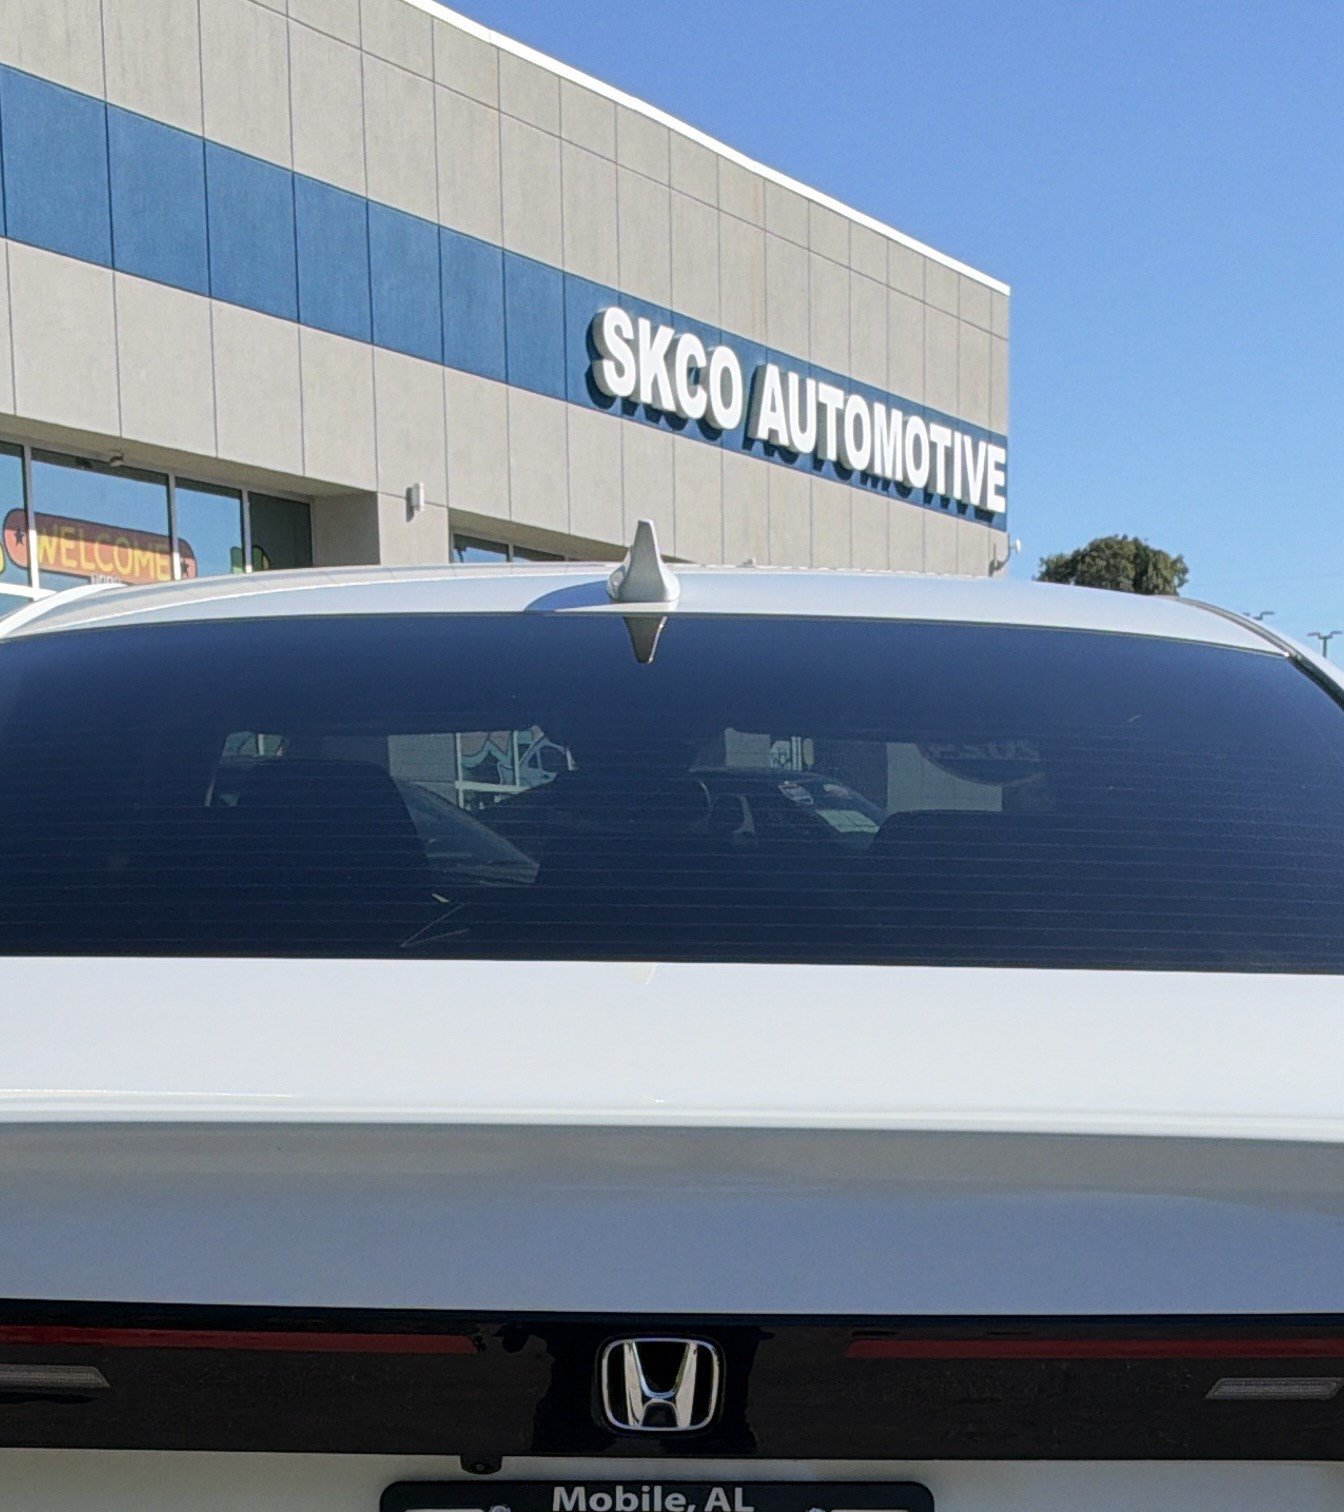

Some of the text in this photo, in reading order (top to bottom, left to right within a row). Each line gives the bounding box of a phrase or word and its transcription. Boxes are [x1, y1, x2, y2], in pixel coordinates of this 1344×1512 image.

[594, 307, 1007, 514] SKCO AUTOMOTIVE
[38, 525, 173, 581] WELCOME
[704, 1487, 754, 1512] AL
